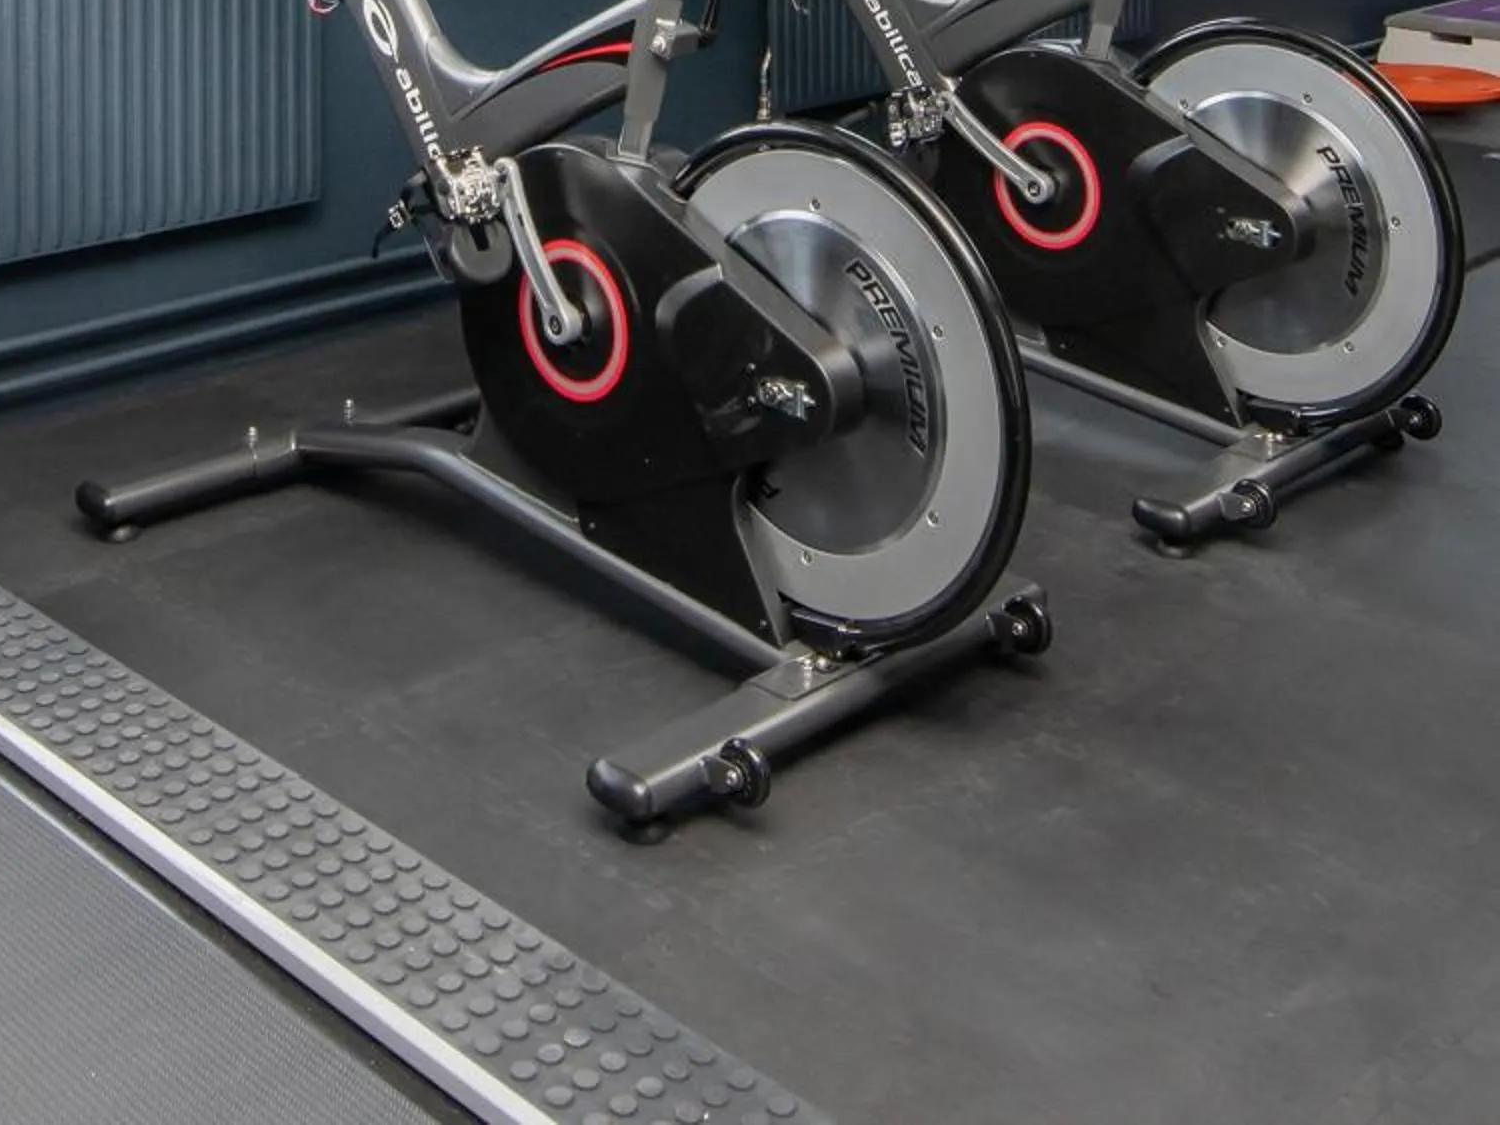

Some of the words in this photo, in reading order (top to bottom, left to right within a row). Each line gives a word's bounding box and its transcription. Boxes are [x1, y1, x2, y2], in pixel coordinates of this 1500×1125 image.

[396, 67, 441, 160] abilic
[1316, 146, 1368, 296] PREMIUM
[845, 259, 927, 454] PREMIUM
